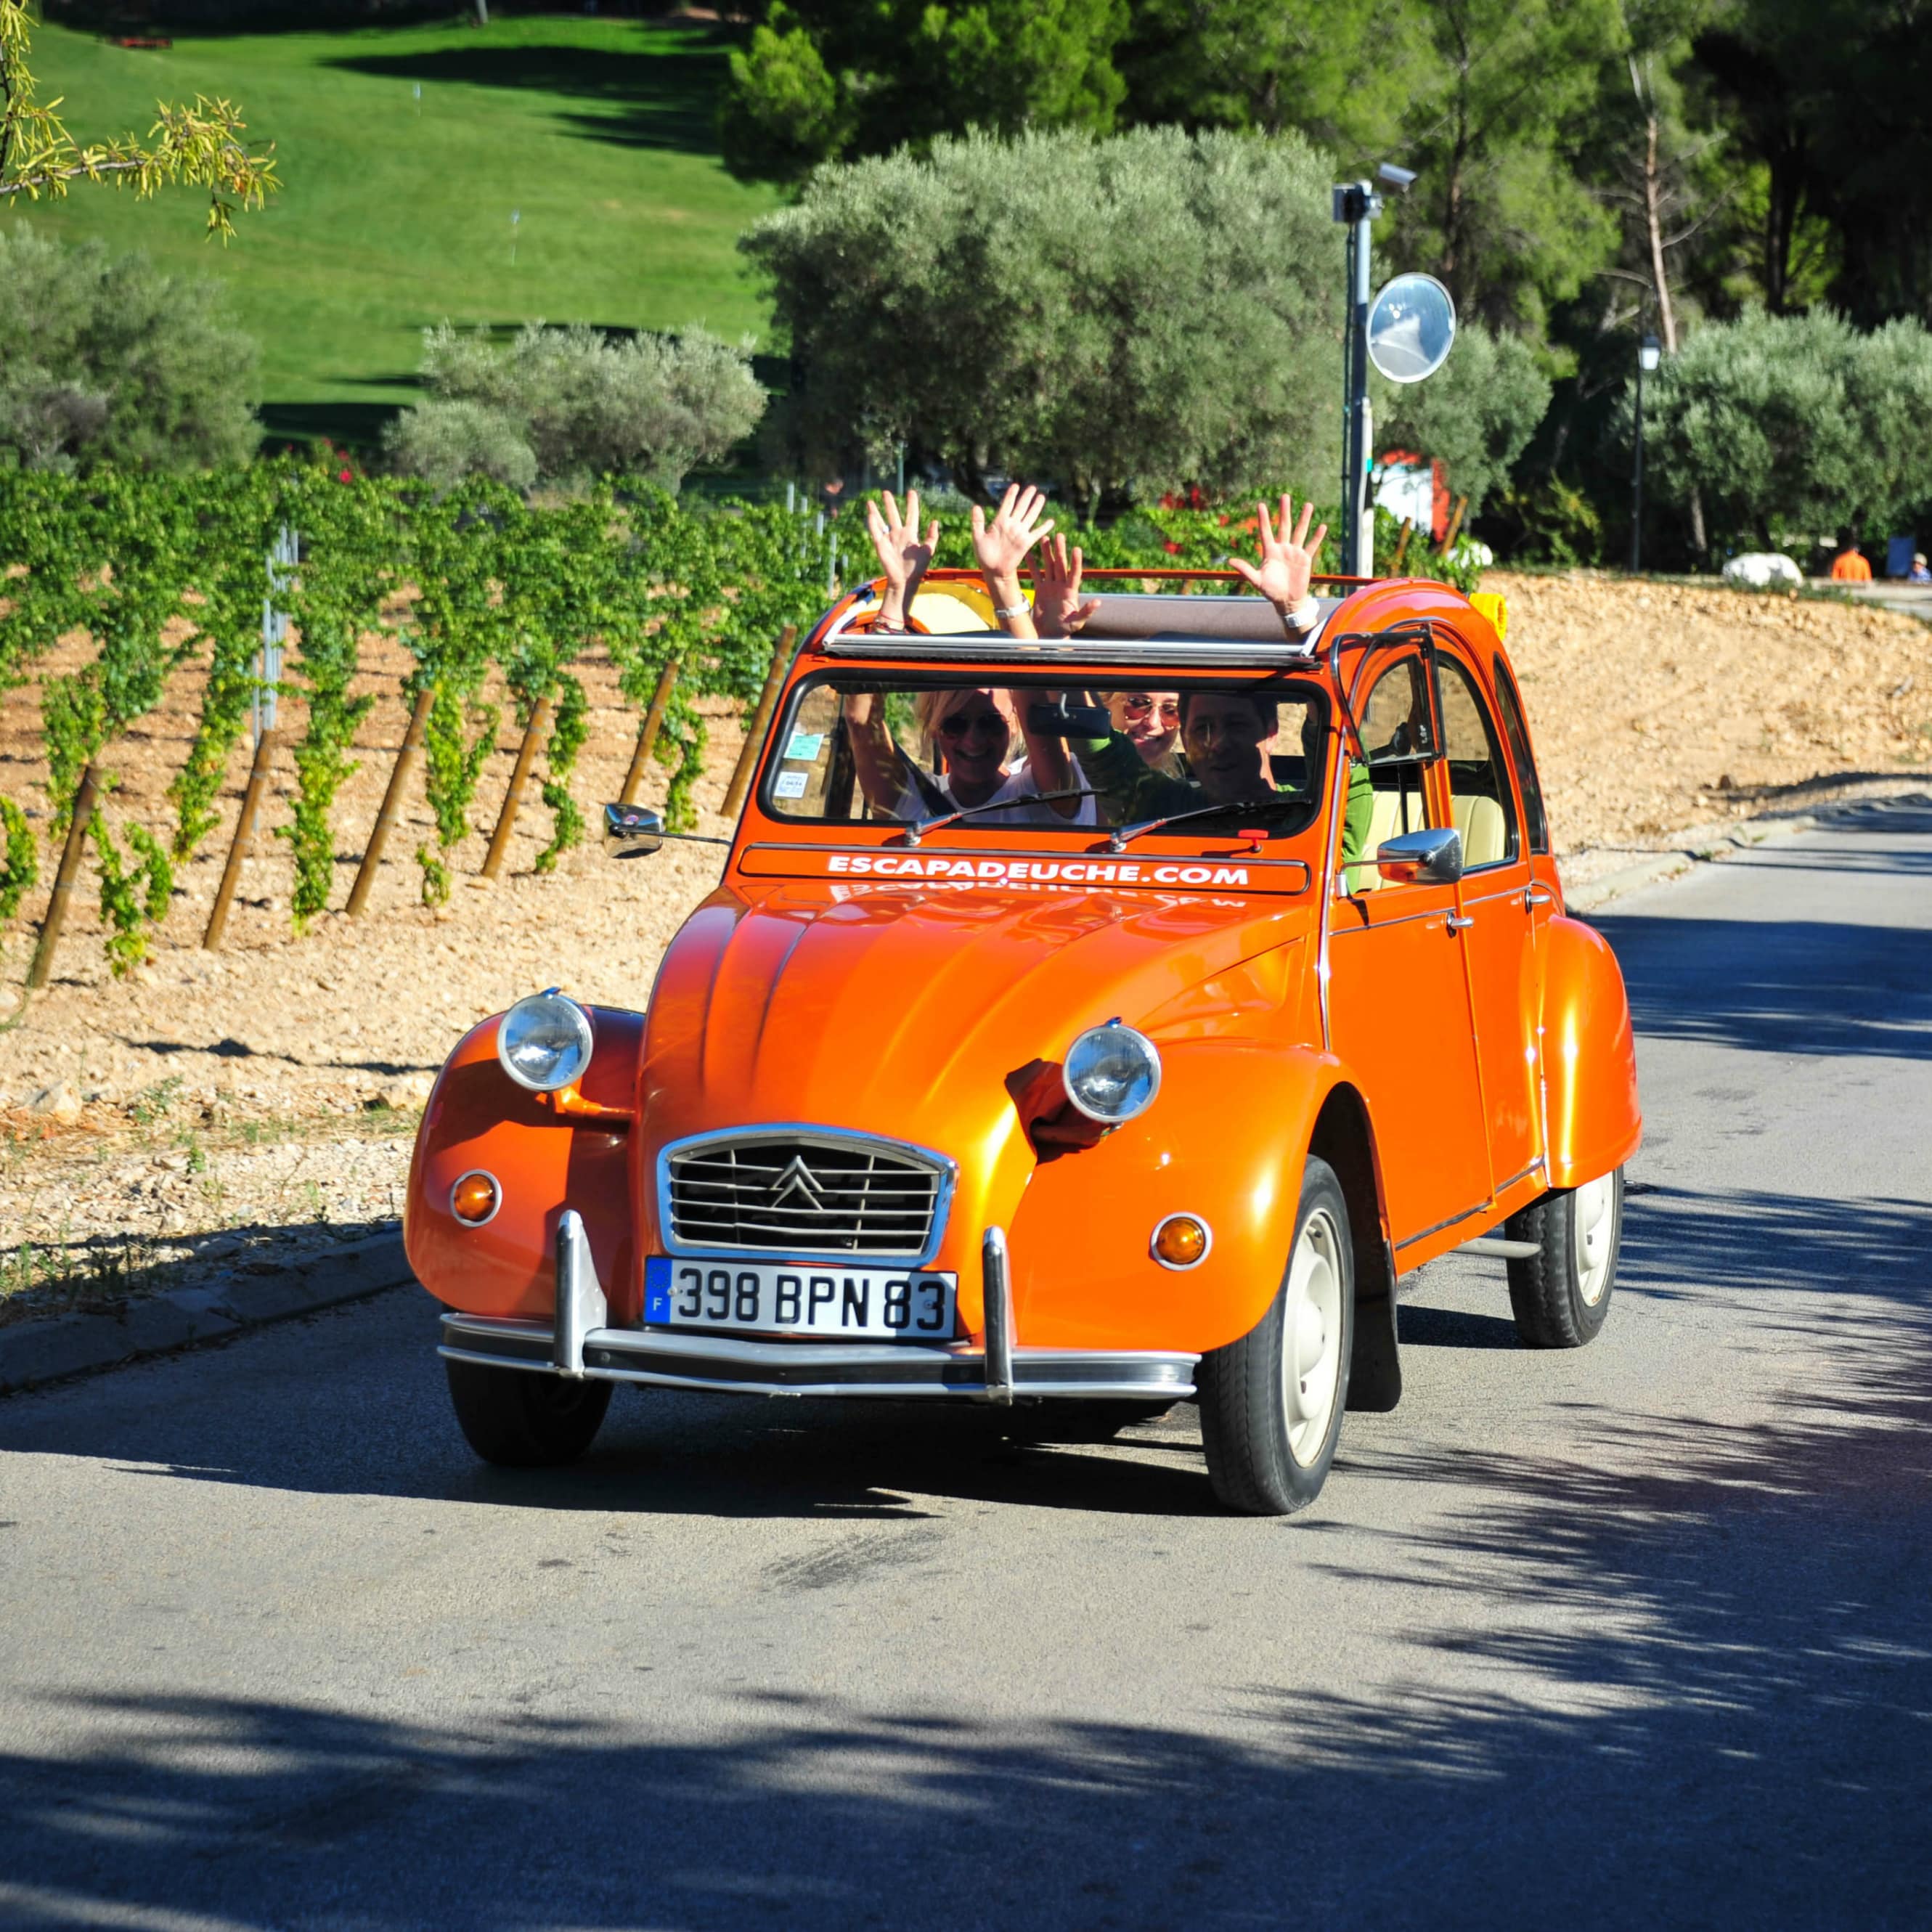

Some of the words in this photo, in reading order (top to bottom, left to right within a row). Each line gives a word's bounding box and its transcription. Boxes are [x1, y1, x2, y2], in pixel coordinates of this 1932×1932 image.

[827, 855, 1248, 884] ESCAPADEUCHE.COM
[653, 1297, 662, 1311] F
[679, 1268, 759, 1322] 398
[775, 1274, 869, 1327] BPN
[884, 1280, 945, 1330] 83
